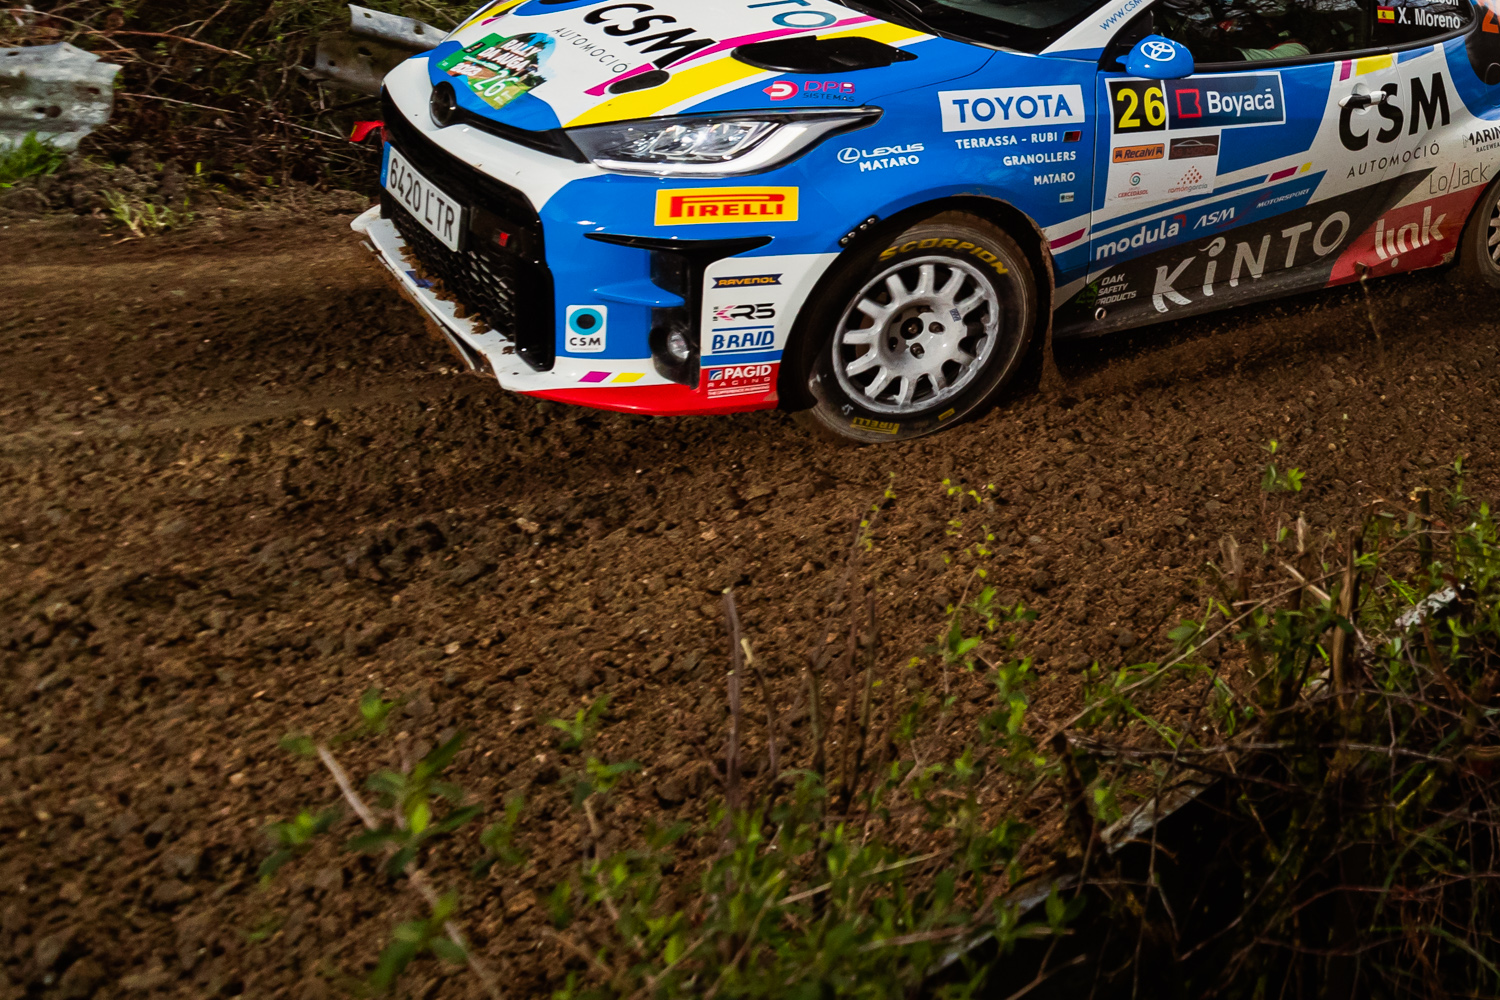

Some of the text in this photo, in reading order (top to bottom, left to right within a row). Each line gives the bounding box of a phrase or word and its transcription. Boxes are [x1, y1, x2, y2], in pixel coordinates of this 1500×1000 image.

[1397, 6, 1461, 29] X. Moreno
[583, 2, 717, 70] CSM
[552, 27, 628, 74] AUTOMOCIÓ
[473, 68, 520, 97] 26
[804, 80, 856, 94] DPB
[802, 92, 856, 103] SISTEMAS
[1116, 86, 1167, 129] 26
[952, 93, 1074, 124] TOYOTA
[1339, 71, 1450, 152] CSM
[861, 142, 925, 157] LEXUS
[955, 134, 1018, 150] TERRASSA
[1031, 131, 1058, 144] RUBI
[859, 155, 920, 173] MATARO
[1002, 150, 1077, 167] GRANOLLERS
[1123, 147, 1155, 160] Recalvi
[1347, 140, 1440, 179] AUTOMOCIÓ
[1033, 171, 1076, 186] MATARO
[390, 158, 455, 242] 6420 LTR
[669, 193, 786, 218] PIRELLI
[1256, 187, 1311, 209] MOTORSPORT
[1192, 206, 1236, 230] ASM
[1096, 220, 1180, 261] modula
[1375, 205, 1447, 264] link
[879, 237, 1009, 275] SCORPION
[718, 276, 777, 286] RAVENOL
[1097, 282, 1129, 297] SAFETY
[1101, 272, 1126, 286] OAK
[1095, 290, 1137, 306] PRODUCTS
[569, 337, 601, 347] CSM
[711, 330, 775, 351] BRAID
[707, 376, 771, 388] RACING
[724, 364, 773, 380] PAGID
